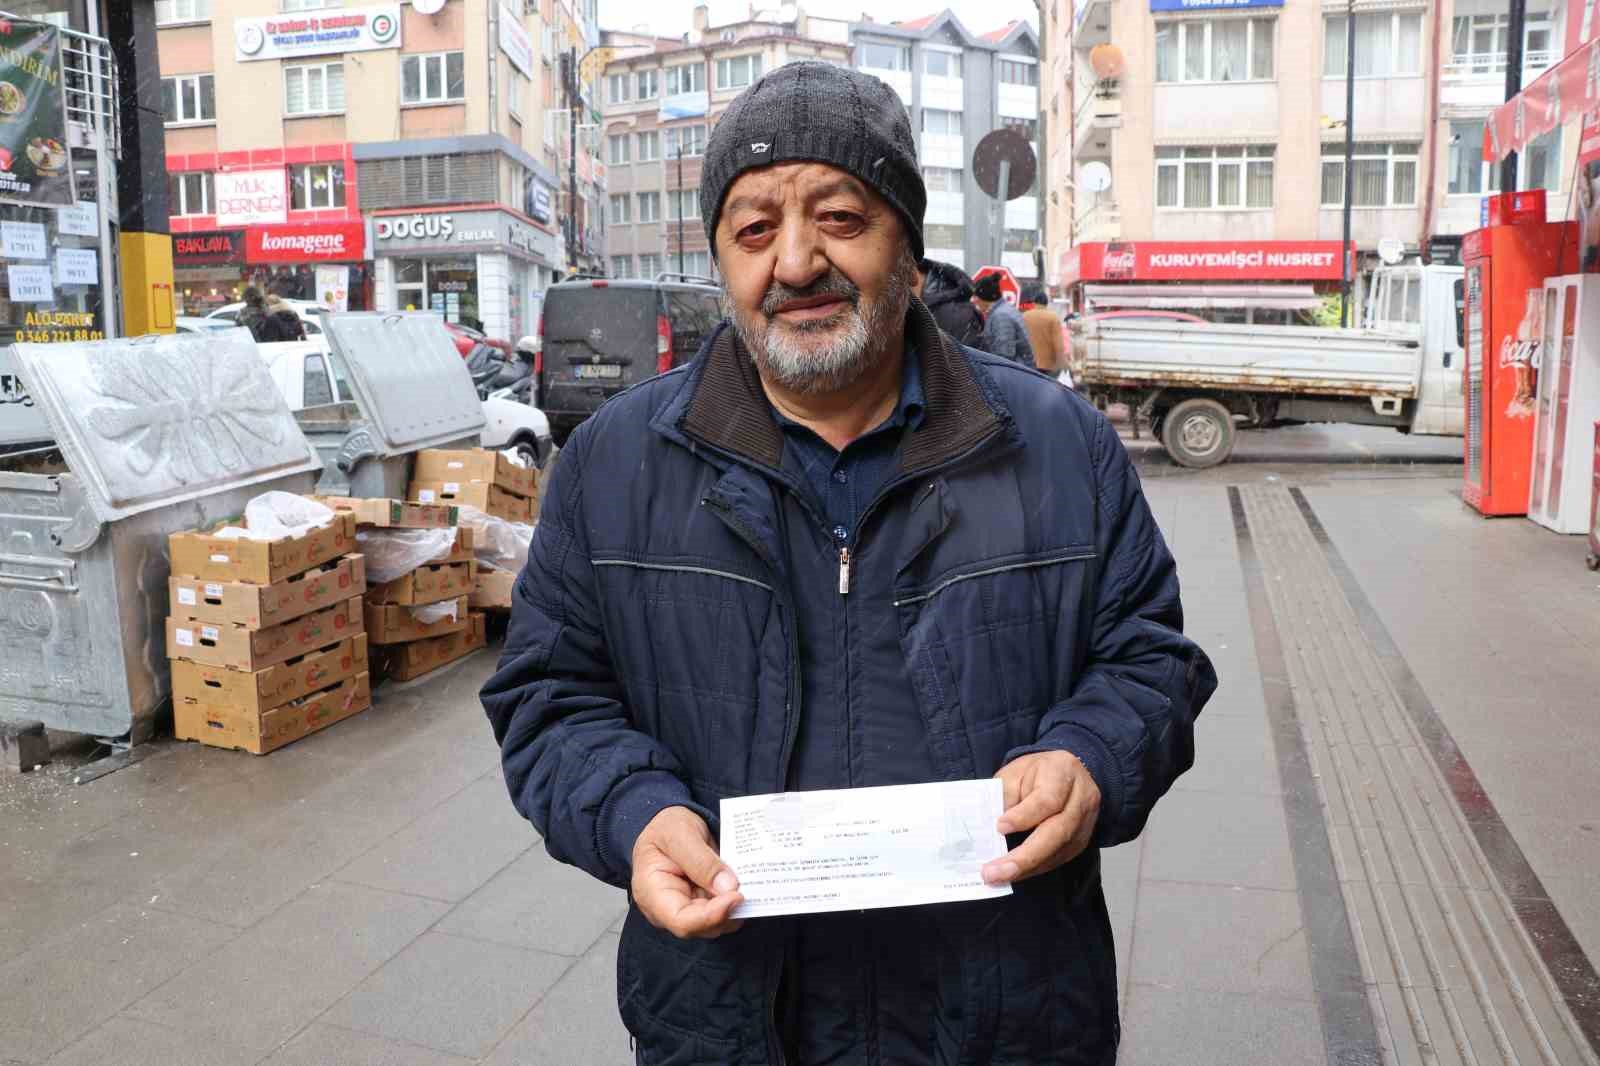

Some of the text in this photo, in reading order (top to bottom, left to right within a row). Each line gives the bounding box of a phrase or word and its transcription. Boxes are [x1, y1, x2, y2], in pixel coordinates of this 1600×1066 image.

[376, 214, 454, 240] DOĞUŞ
[457, 229, 496, 242] EMLAK
[176, 237, 232, 254] BAKLAVA
[262, 232, 344, 254] komagene
[1268, 252, 1334, 267] NUSRET
